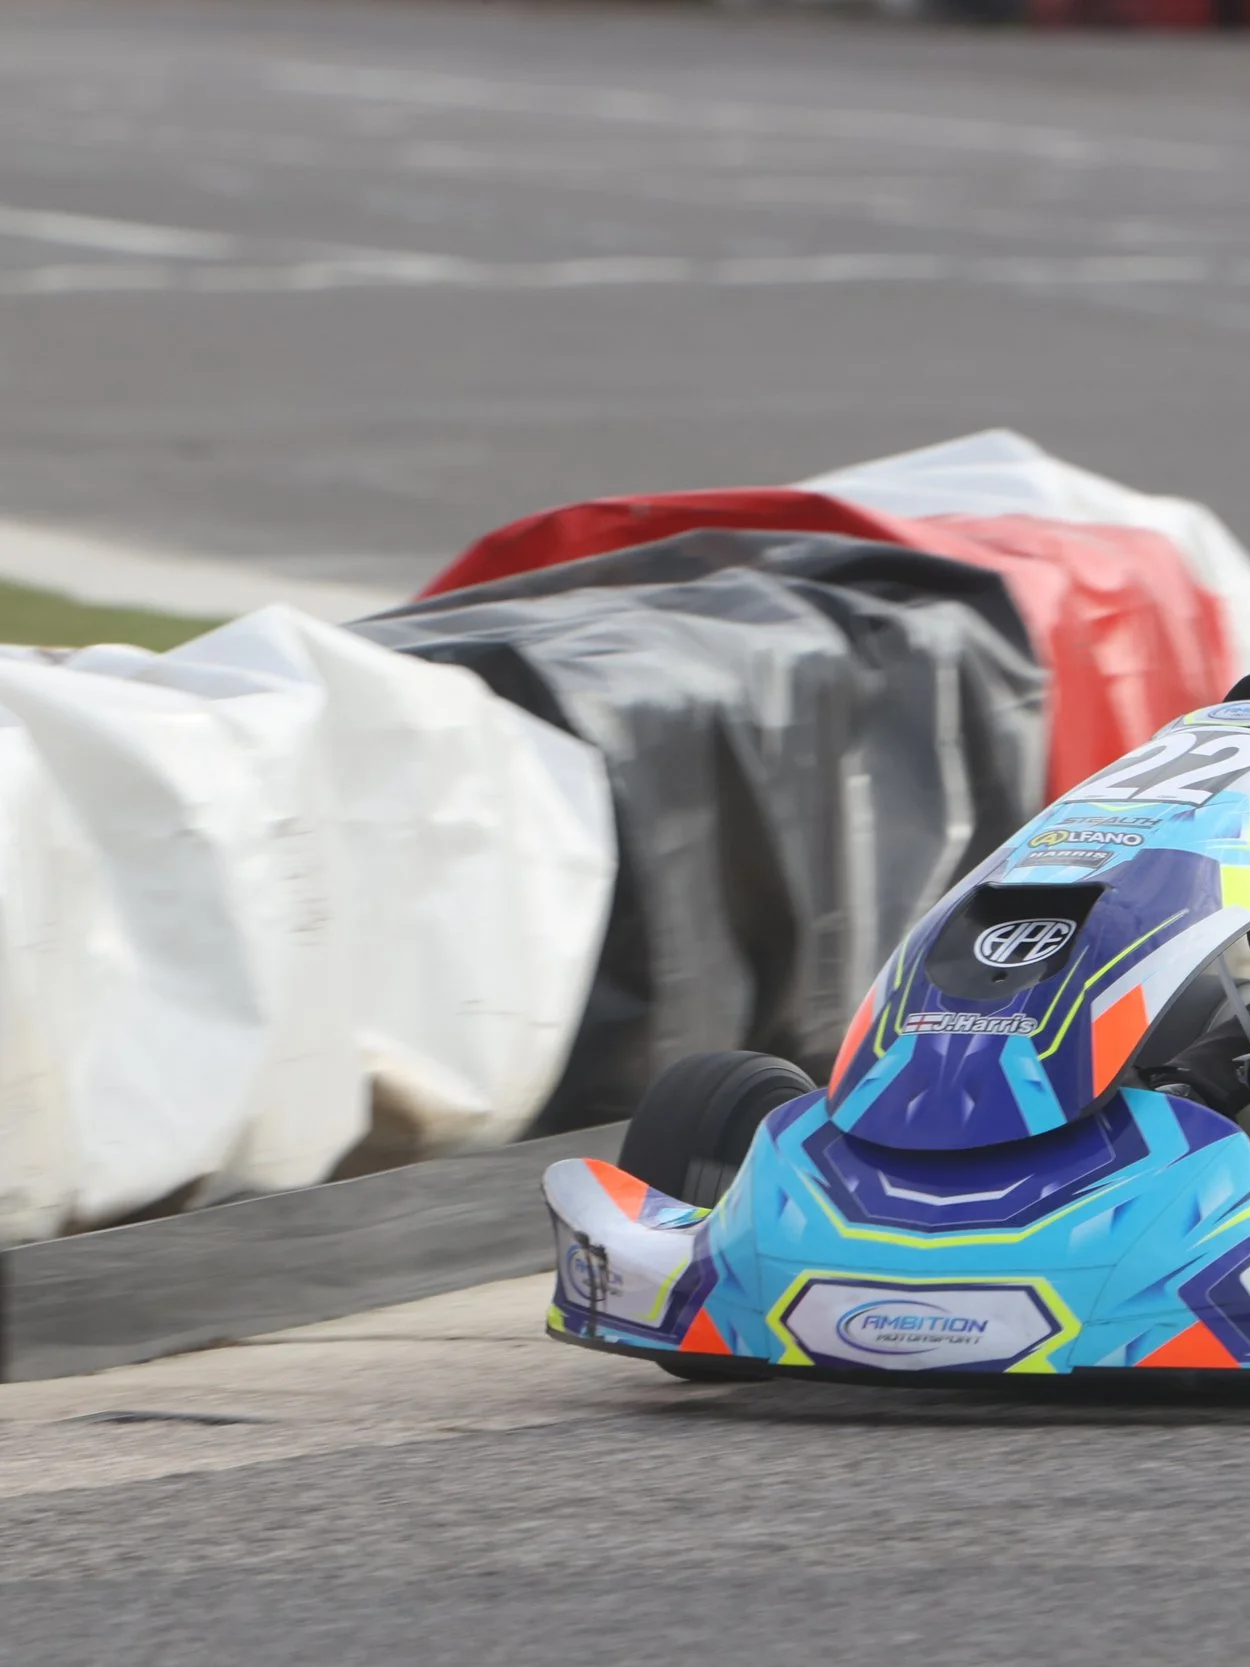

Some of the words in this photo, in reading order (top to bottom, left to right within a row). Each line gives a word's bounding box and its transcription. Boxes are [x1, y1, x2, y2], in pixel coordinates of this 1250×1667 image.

[1030, 830, 1143, 848] ALFANO
[931, 1014, 1036, 1033] J.Harris
[861, 1315, 989, 1333] AMBITION
[876, 1333, 981, 1345] MOTORSPORT
